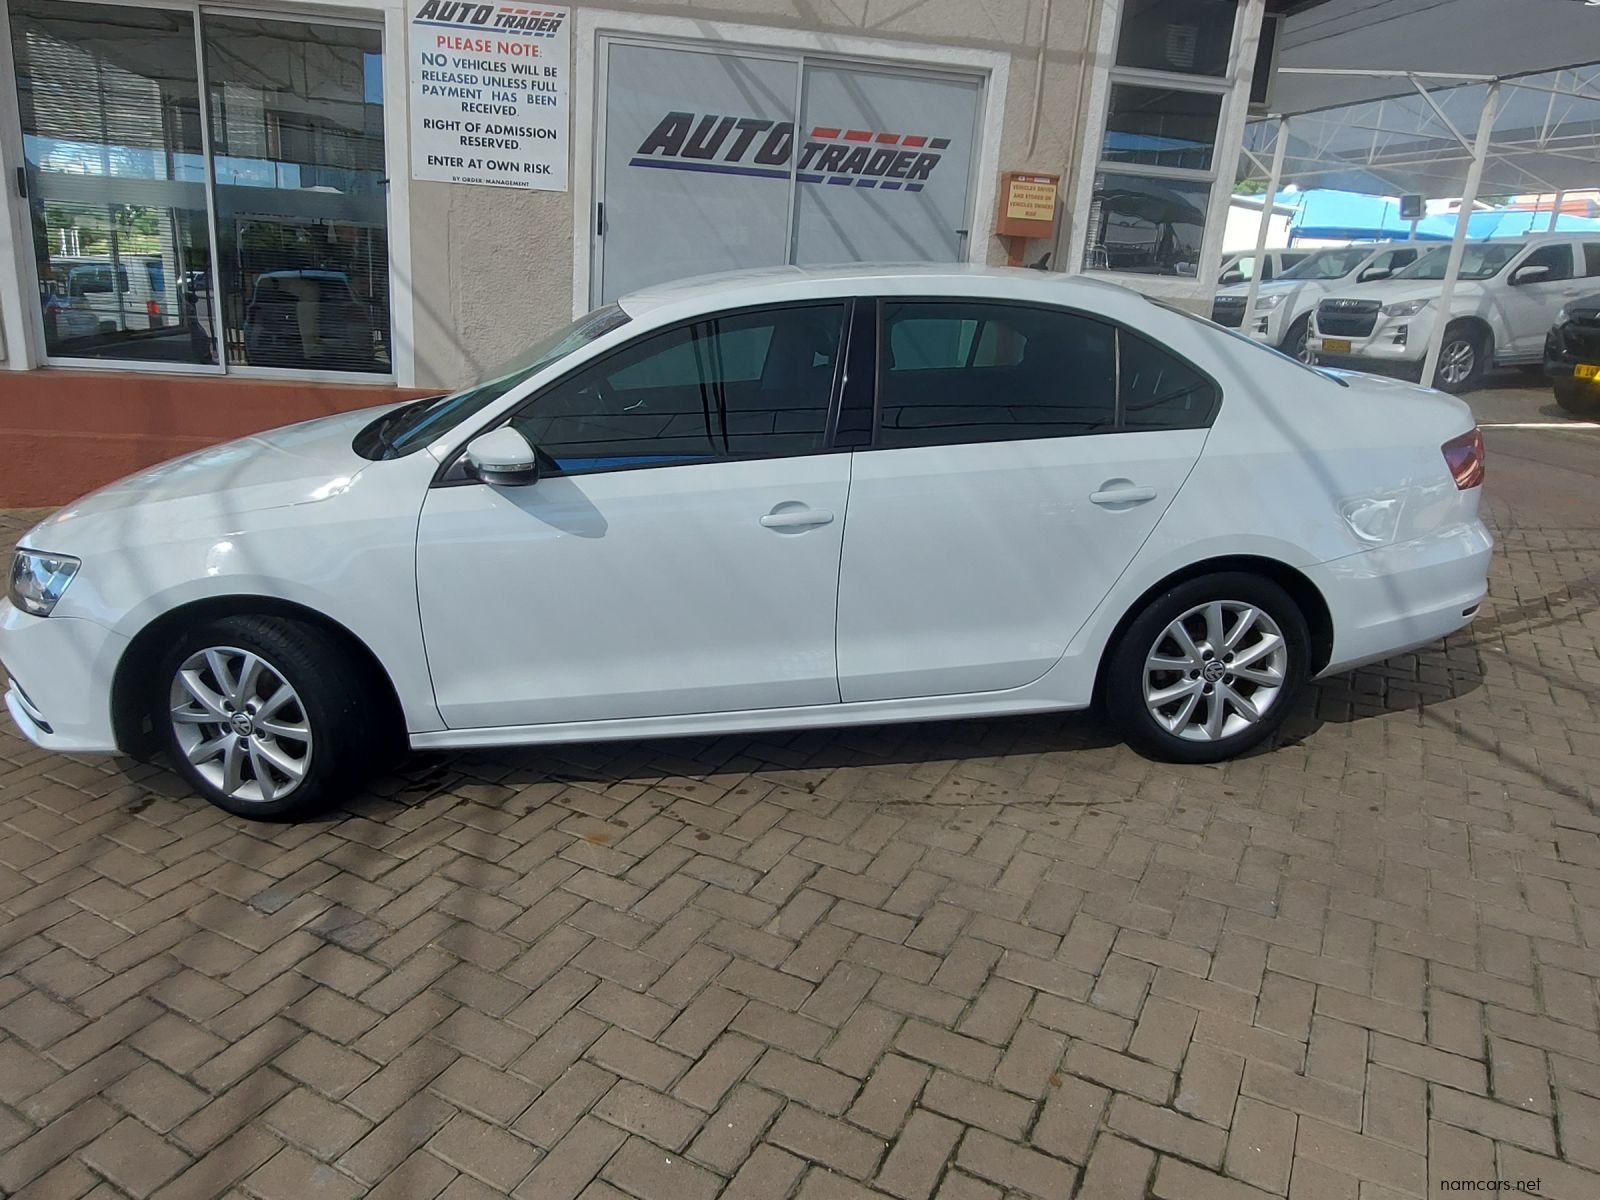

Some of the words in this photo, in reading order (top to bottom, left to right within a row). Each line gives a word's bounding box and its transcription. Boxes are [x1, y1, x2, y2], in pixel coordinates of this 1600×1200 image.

[416, 0, 494, 25] AUTO
[494, 14, 563, 33] TRADER
[437, 36, 492, 53] PLEASE
[498, 42, 542, 58] NOTE:
[421, 52, 448, 67] NO
[452, 57, 506, 73] VEHICLES
[511, 63, 539, 76] WILL
[544, 67, 557, 77] BE
[421, 70, 478, 85] RELEASED
[482, 76, 527, 90] UNLESS
[531, 80, 557, 92] FULL
[422, 85, 482, 100] PAYMENT
[492, 91, 517, 103] HAS
[527, 94, 557, 106] BEEN
[461, 102, 520, 116] RECEIVED.
[423, 118, 461, 131] RIGHT
[465, 122, 481, 133] OF
[485, 124, 557, 139] ADMISSION
[460, 136, 522, 150] RESERVED.
[637, 111, 801, 166] AUTO
[798, 141, 941, 180] TRADER
[427, 155, 464, 168] ENTER
[468, 158, 483, 169] AT
[486, 160, 520, 172] OWN
[524, 163, 553, 175] RISK.
[486, 179, 529, 187] MANAGEMENT
